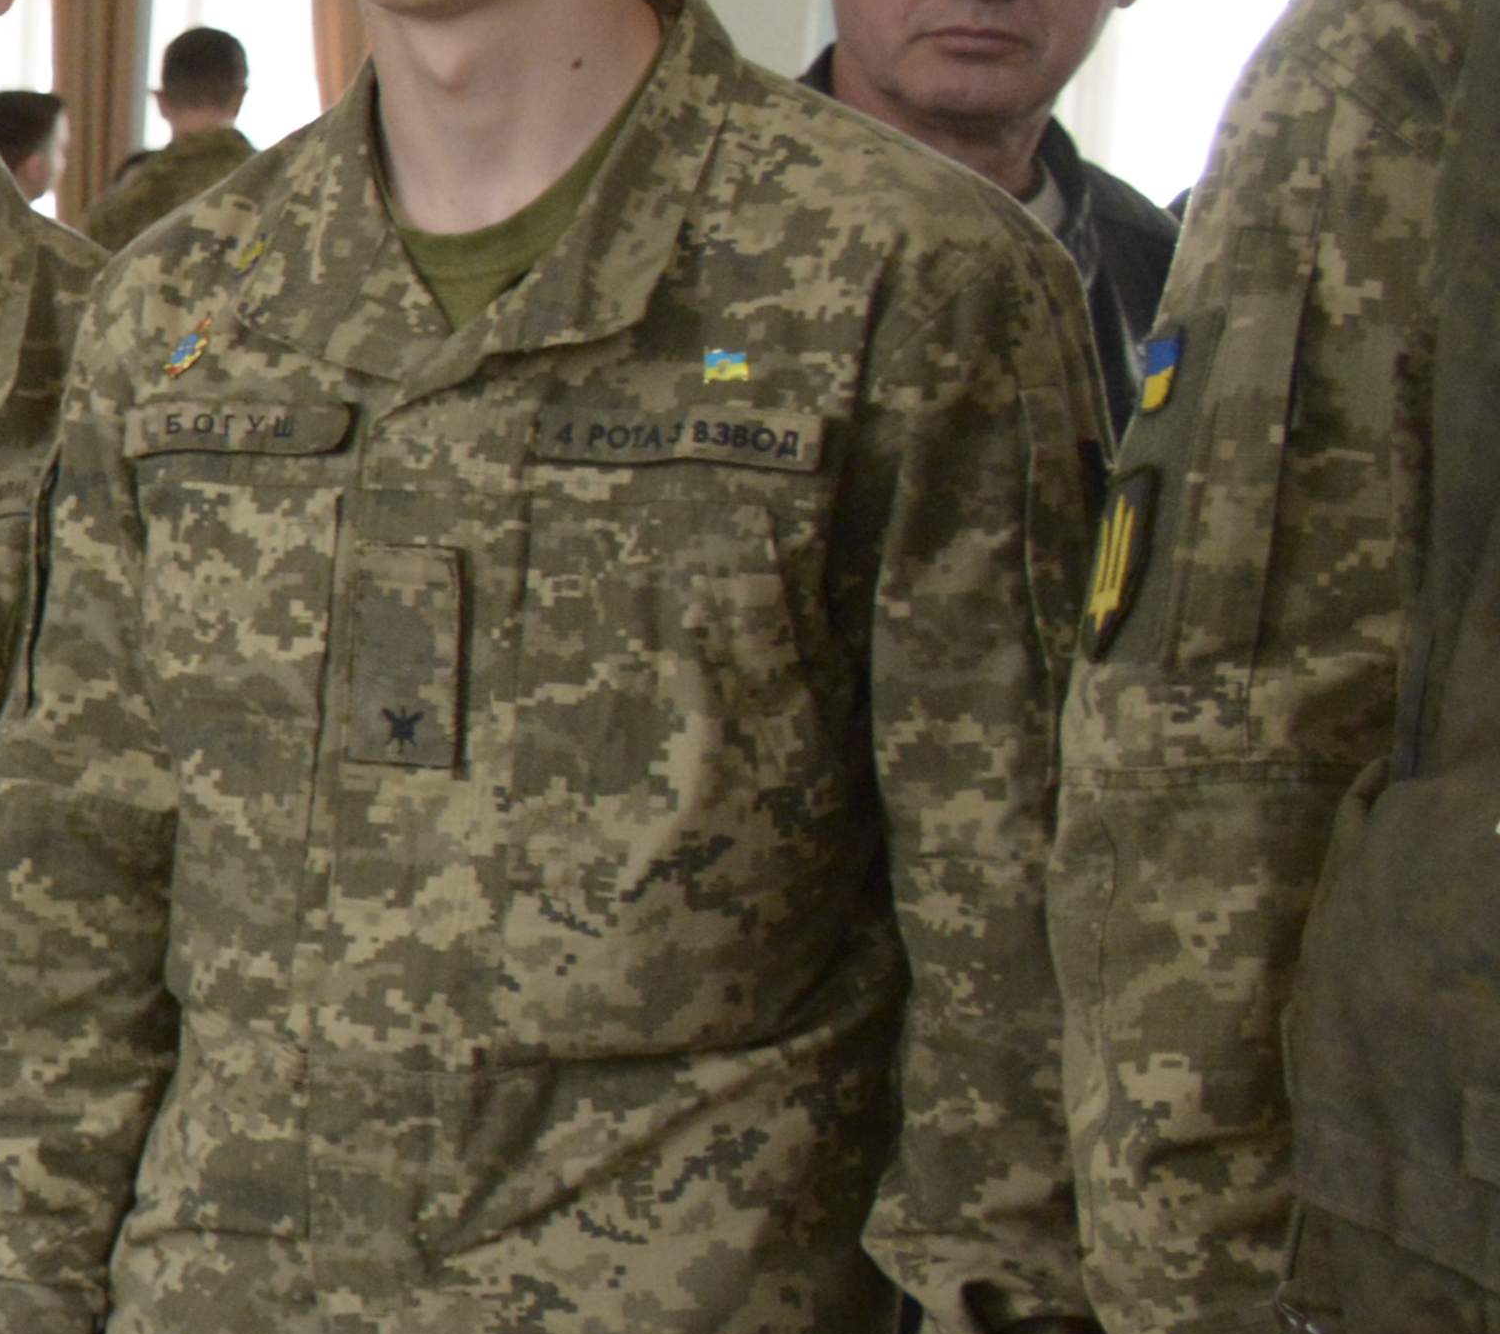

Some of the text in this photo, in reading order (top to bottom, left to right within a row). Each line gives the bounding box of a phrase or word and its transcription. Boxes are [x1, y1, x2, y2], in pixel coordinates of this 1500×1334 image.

[165, 412, 294, 439] БОГУШ
[554, 422, 575, 446] 4
[588, 423, 662, 452] РОТА
[692, 420, 800, 458] ВЗВОД
